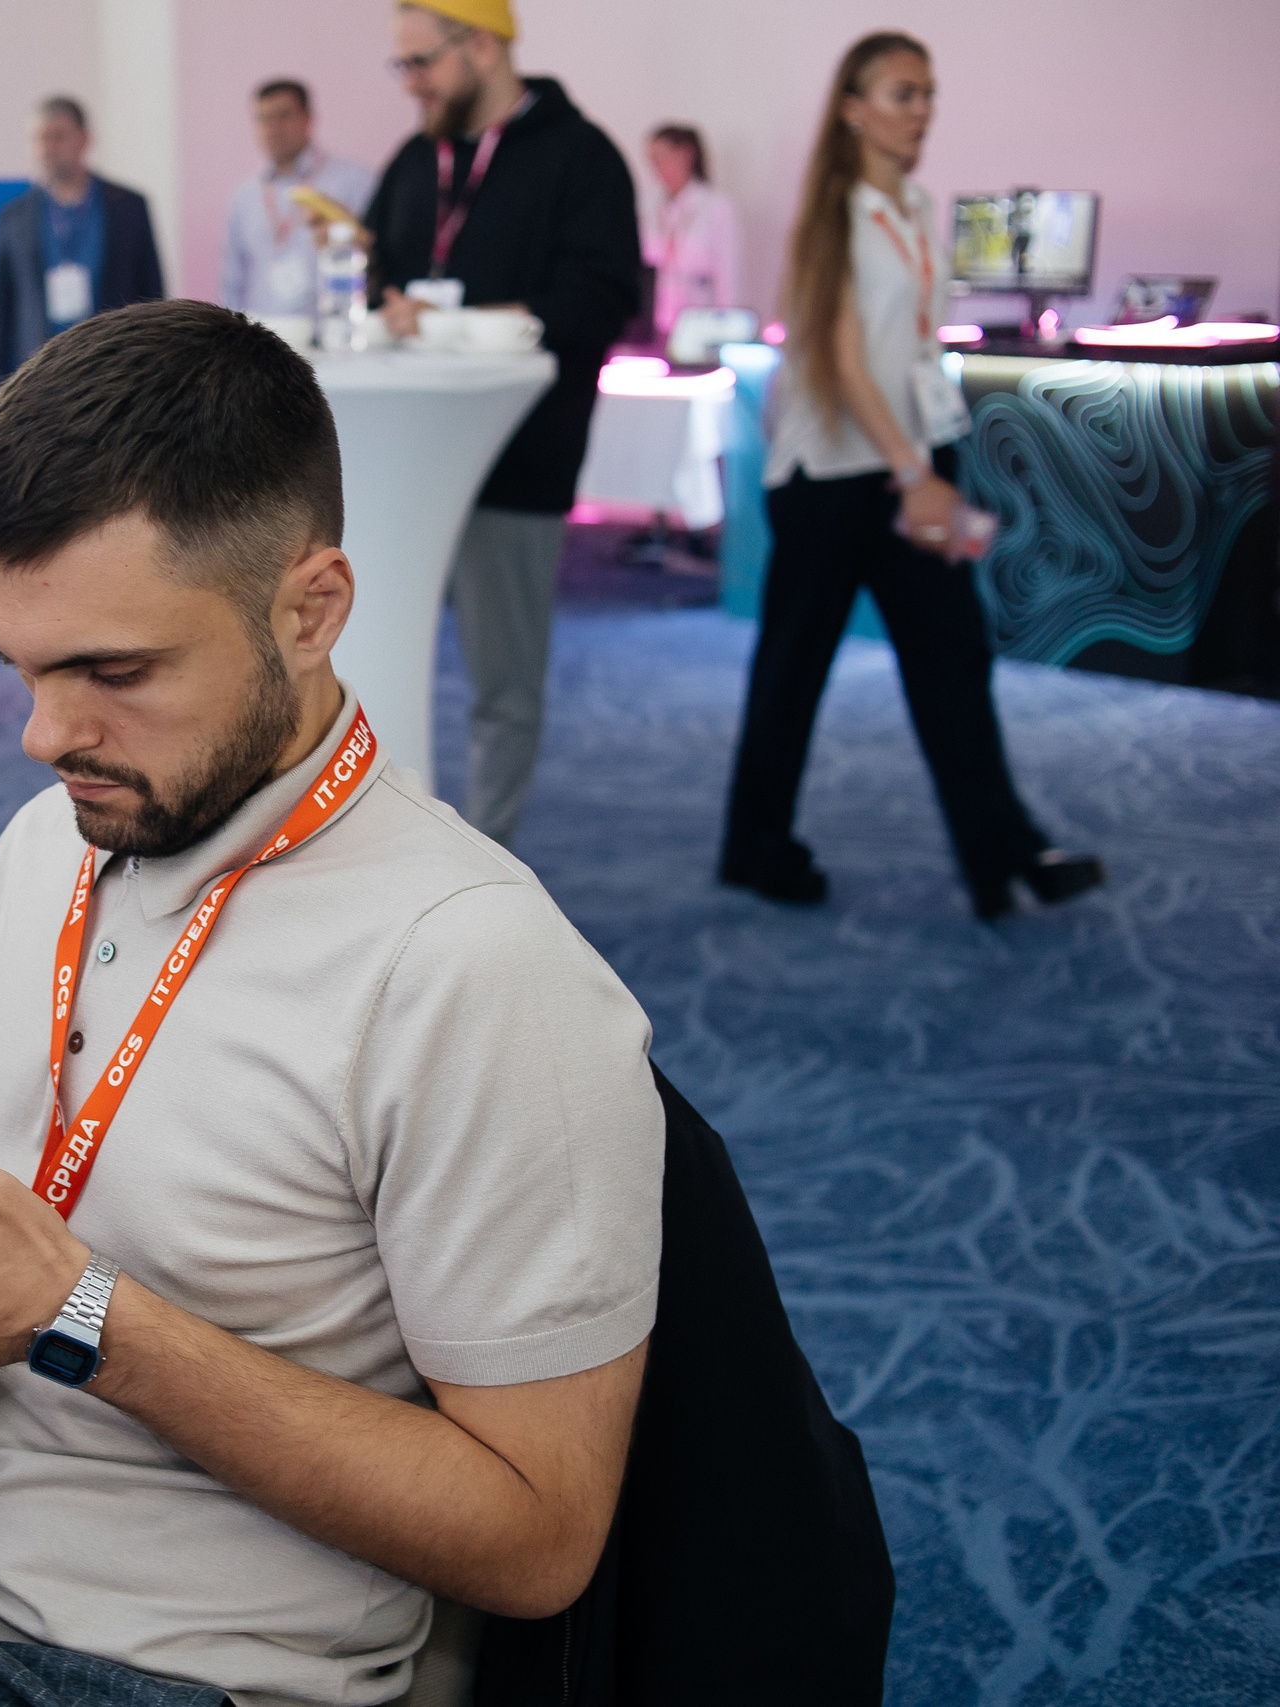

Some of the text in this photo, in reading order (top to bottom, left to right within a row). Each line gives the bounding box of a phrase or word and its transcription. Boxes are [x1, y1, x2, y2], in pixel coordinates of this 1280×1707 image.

[312, 719, 372, 810] IT-СРЕДА
[150, 887, 226, 1007] IT-СРЕДА
[58, 965, 72, 1020] OCS
[107, 1033, 144, 1087] OCS
